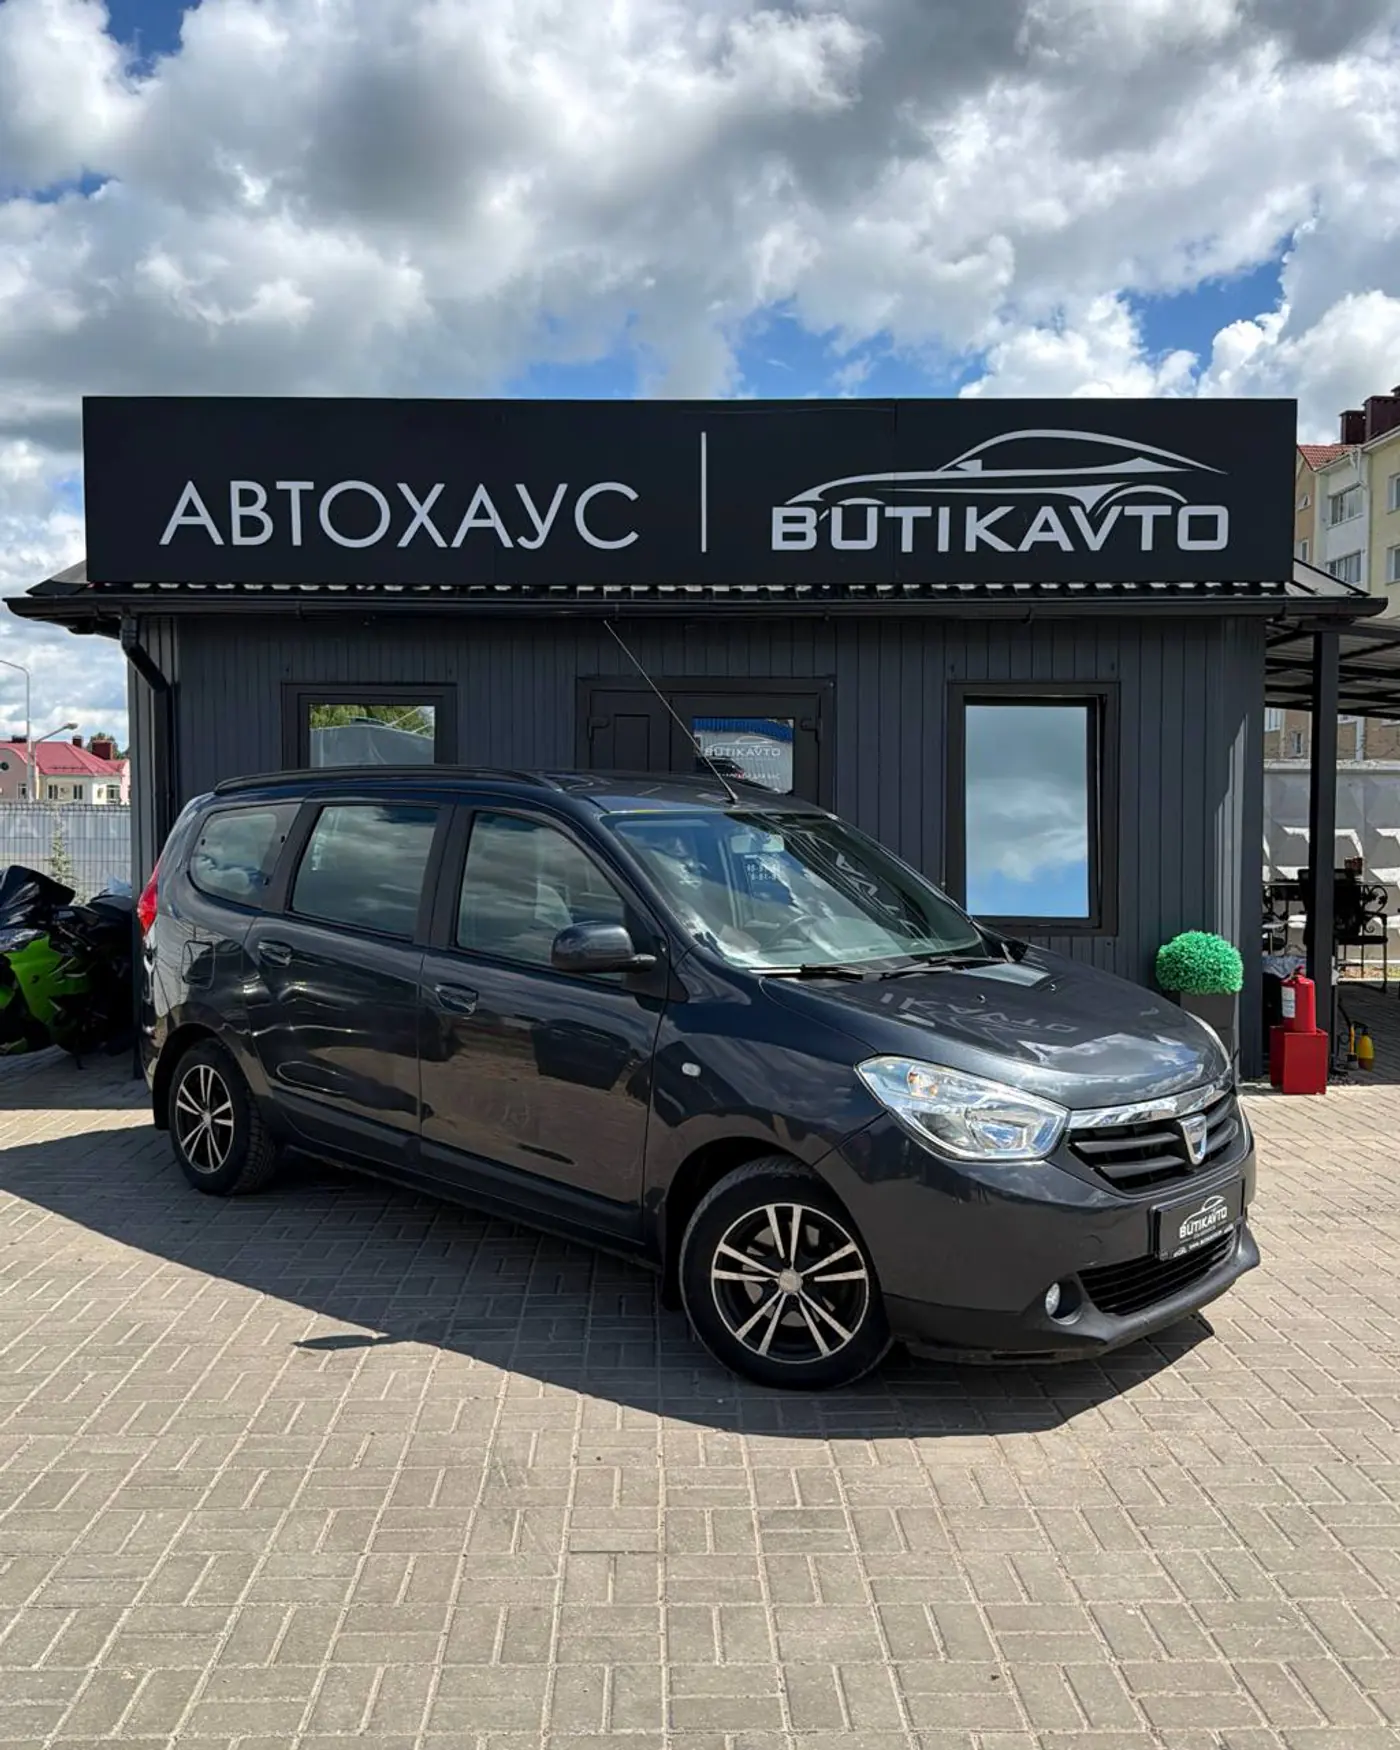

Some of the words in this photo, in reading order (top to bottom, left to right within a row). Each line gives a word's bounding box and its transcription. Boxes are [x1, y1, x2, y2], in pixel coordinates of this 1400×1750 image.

[159, 480, 639, 550] АВТОХАУС
[771, 504, 1230, 553] BUTIKAVTO
[704, 747, 781, 757] BUTIKAVTO
[1179, 1207, 1228, 1239] BUTIKAVTO
